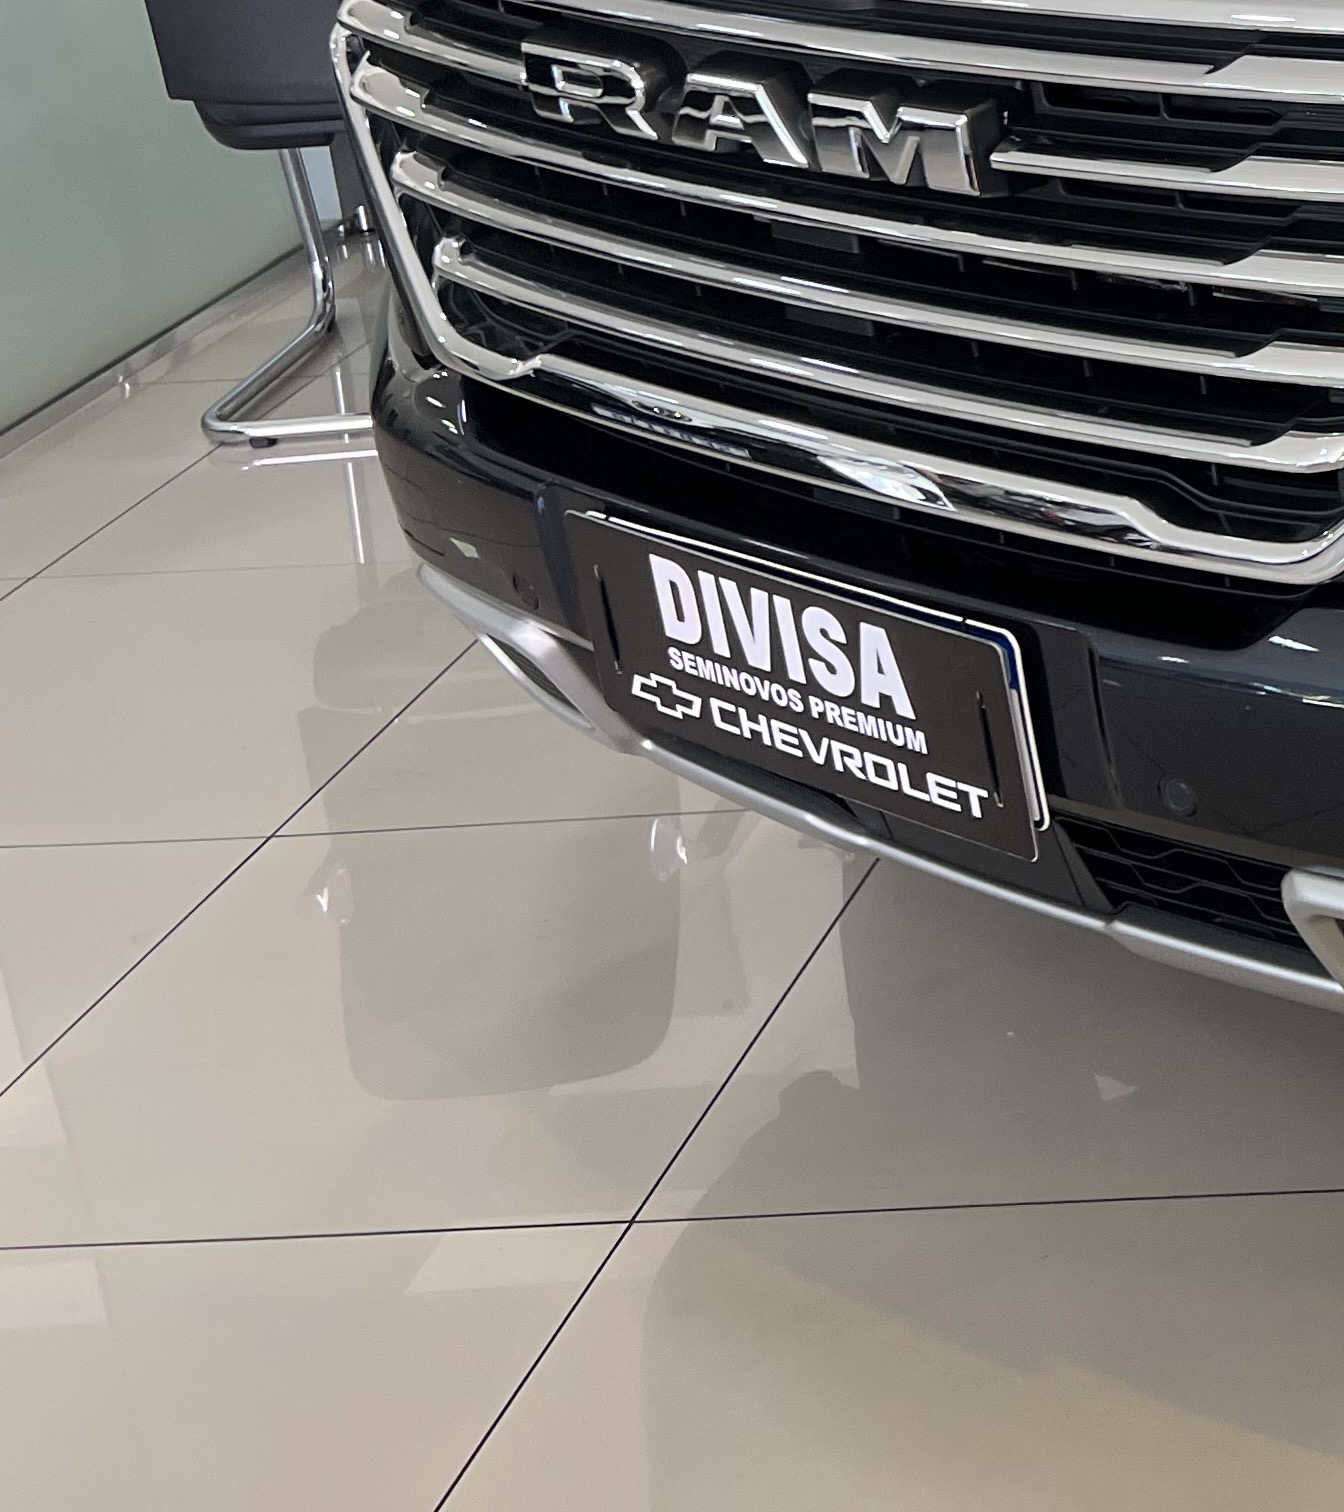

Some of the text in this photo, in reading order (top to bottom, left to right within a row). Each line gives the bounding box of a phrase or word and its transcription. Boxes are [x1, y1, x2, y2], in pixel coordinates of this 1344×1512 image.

[521, 40, 981, 197] RAM
[649, 553, 916, 720] DIVISA
[667, 646, 929, 755] SEMINOVOS PREMIUM
[709, 697, 989, 819] CHEVROLET
